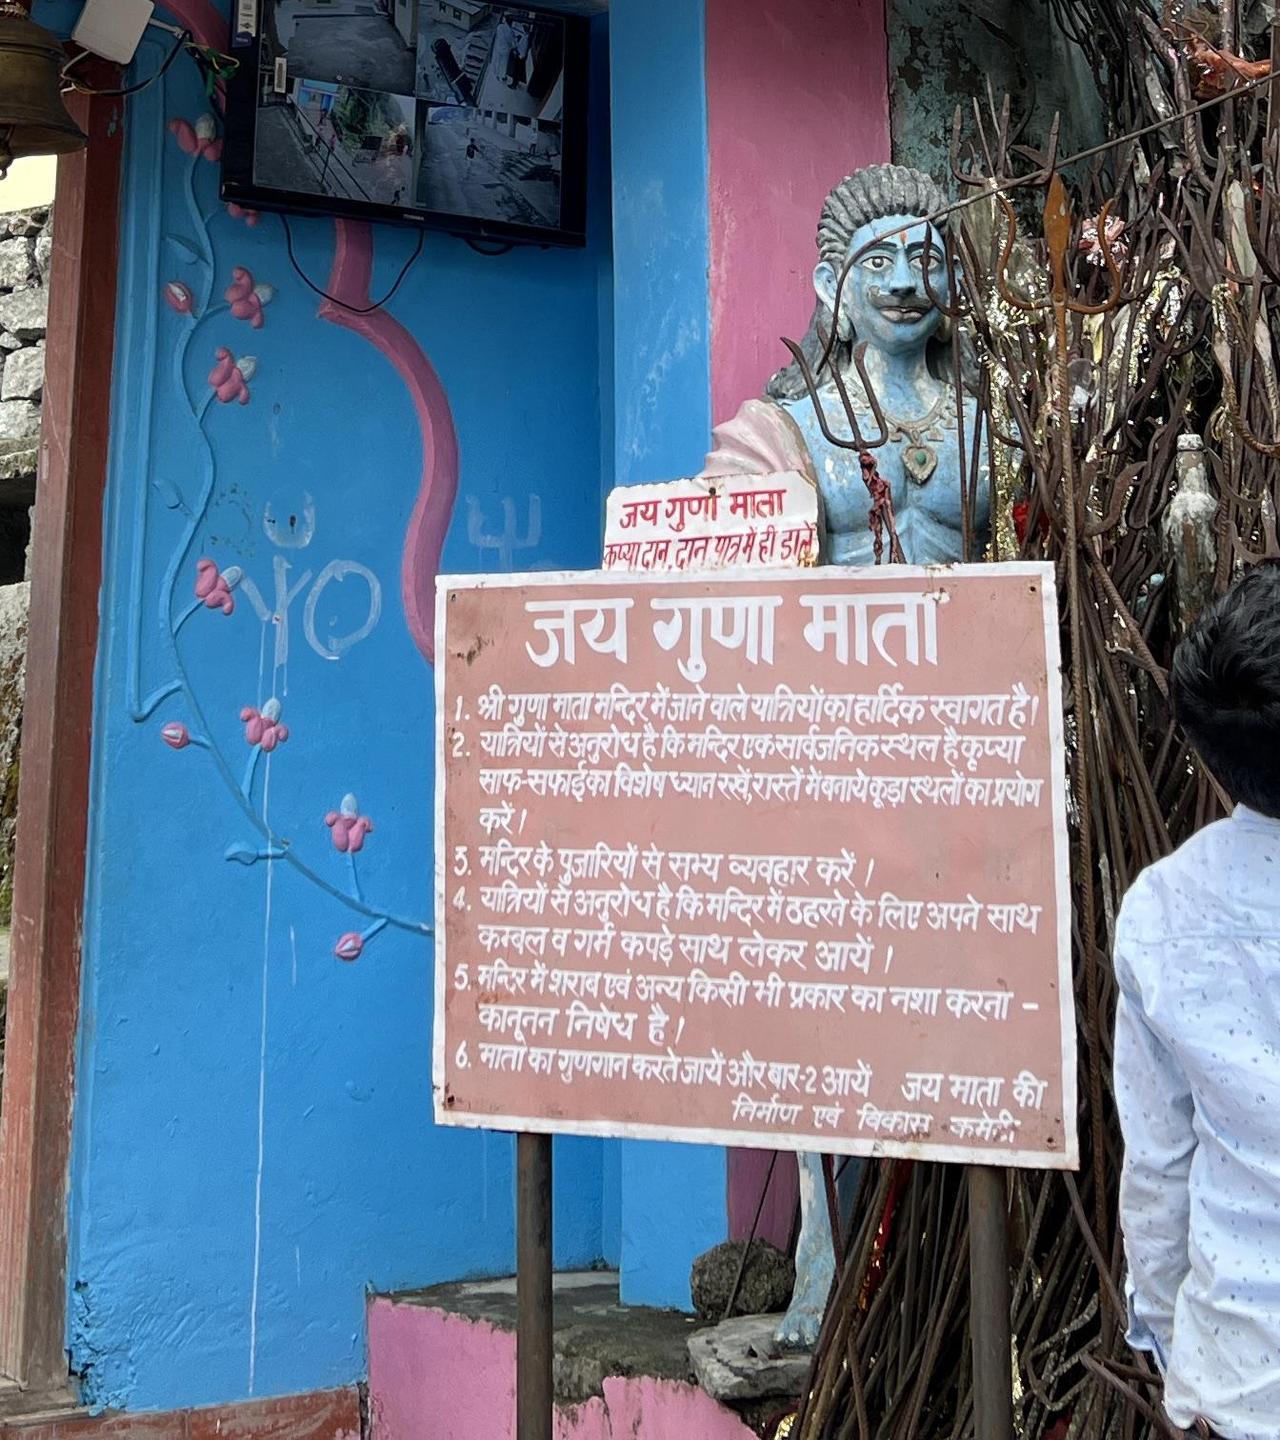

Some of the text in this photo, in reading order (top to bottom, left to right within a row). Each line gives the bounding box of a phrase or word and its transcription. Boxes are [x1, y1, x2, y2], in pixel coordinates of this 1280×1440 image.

[620, 499, 662, 529] जय
[729, 489, 787, 519] माता
[676, 535, 712, 568] दान
[715, 533, 744, 564] पात्र
[743, 526, 758, 564] में
[759, 524, 779, 564] ही
[524, 592, 947, 682] जय गुणा माता
[455, 695, 470, 721] 1.
[478, 684, 506, 720] श्री
[509, 692, 550, 726] गुणा
[553, 693, 594, 720] माता
[595, 682, 650, 725] मन्दिर
[651, 682, 671, 720] में
[710, 683, 750, 721] वाले
[751, 683, 826, 722] यात्रियों
[824, 694, 855, 722] का
[855, 682, 928, 727] हार्दिक
[930, 694, 1010, 726] स्वागत
[452, 732, 470, 757] 2.
[480, 723, 548, 758] यात्रियों
[549, 722, 569, 758] से
[568, 723, 641, 764] अनुरोध
[642, 721, 659, 761] है
[660, 724, 685, 758] कि
[687, 724, 741, 763] मन्दिर
[742, 733, 775, 759] एक
[775, 724, 880, 762] सार्वजनिक
[880, 733, 942, 762] स्थल
[943, 725, 961, 768] है
[614, 761, 668, 799] विशेष
[668, 770, 717, 799] ध्यान
[805, 765, 823, 801] में
[869, 775, 909, 809] कूड़ा
[910, 768, 965, 806] स्थलों
[964, 778, 993, 806] का
[992, 770, 1044, 808] प्रयोग
[478, 838, 533, 879] मन्दिर
[533, 840, 554, 877] के
[557, 841, 639, 885] पुजारियों
[642, 842, 664, 880] से
[669, 852, 724, 883] सभ्य
[728, 854, 813, 886] व्यवहार
[453, 879, 1043, 935] 4. यात्रियों से अनुरोध है कि मन्दिर में ठहरने के लिए अपने साथ
[478, 924, 550, 956] कम्बल
[551, 927, 572, 957] व
[573, 921, 616, 960] गर्म
[620, 924, 675, 967] कपड़े
[679, 933, 733, 965] साथ
[737, 929, 808, 971] लेकर
[453, 963, 471, 991] 5.
[478, 958, 529, 995] मन्दिर
[530, 959, 549, 993] में
[548, 968, 601, 999] शराब
[603, 968, 633, 1000] एवं
[635, 973, 686, 1002] अन्य
[687, 968, 749, 1008] किसी
[753, 971, 785, 1008] भी
[788, 981, 849, 1013] प्रकार
[850, 984, 887, 1014] का
[889, 986, 942, 1017] नशा
[945, 988, 1014, 1021] करना
[478, 1003, 559, 1044] कानूनन
[565, 1000, 638, 1042] निषेध
[455, 1040, 471, 1070] 6.
[478, 1042, 527, 1073] माता
[528, 1048, 554, 1074] का
[557, 1049, 631, 1084] गुणगान
[631, 1046, 678, 1084] करते
[679, 1047, 726, 1087] जायें
[726, 1049, 767, 1089] और
[821, 1059, 873, 1097] आयें
[900, 1072, 945, 1103] जय
[948, 1074, 1005, 1108] माता
[1011, 1070, 1048, 1109] की
[731, 1092, 803, 1125] निर्माण
[812, 1101, 845, 1128] एवं
[857, 1102, 933, 1134] विकास
